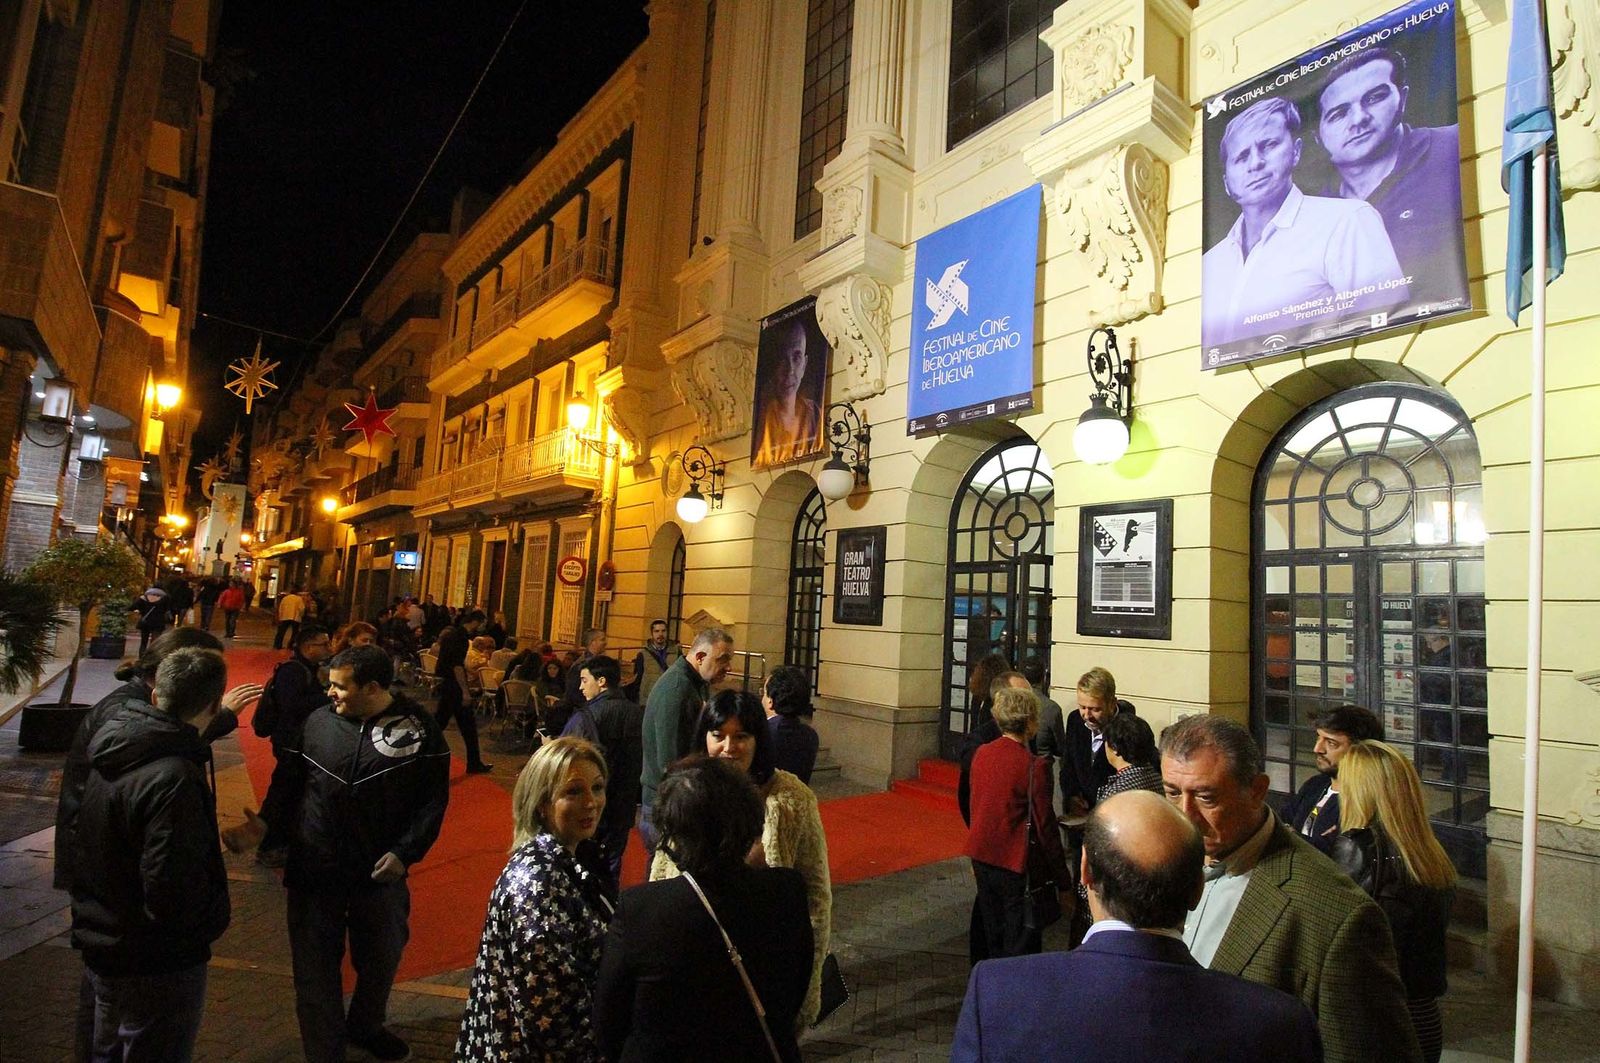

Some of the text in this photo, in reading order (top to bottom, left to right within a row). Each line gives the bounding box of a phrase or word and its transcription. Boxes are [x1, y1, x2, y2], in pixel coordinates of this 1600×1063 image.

[1228, 86, 1266, 111] FESTIVAL
[1275, 67, 1300, 88] CINE
[1300, 28, 1391, 76] IBEROAMERICANO
[1393, 24, 1404, 35] DE
[1405, 1, 1450, 29] HUELVA
[1243, 274, 1414, 325] Alfonso Sánchez y Alberto López
[923, 315, 1011, 356] FESTIVAL DE CINE
[922, 332, 1021, 374] IBEROAMERICANO
[921, 367, 974, 391] DE HUELVA
[844, 551, 865, 566] GRAN
[843, 566, 871, 581] TEATRO
[842, 581, 870, 596] HUELVA
[1390, 601, 1412, 609] HUELV
